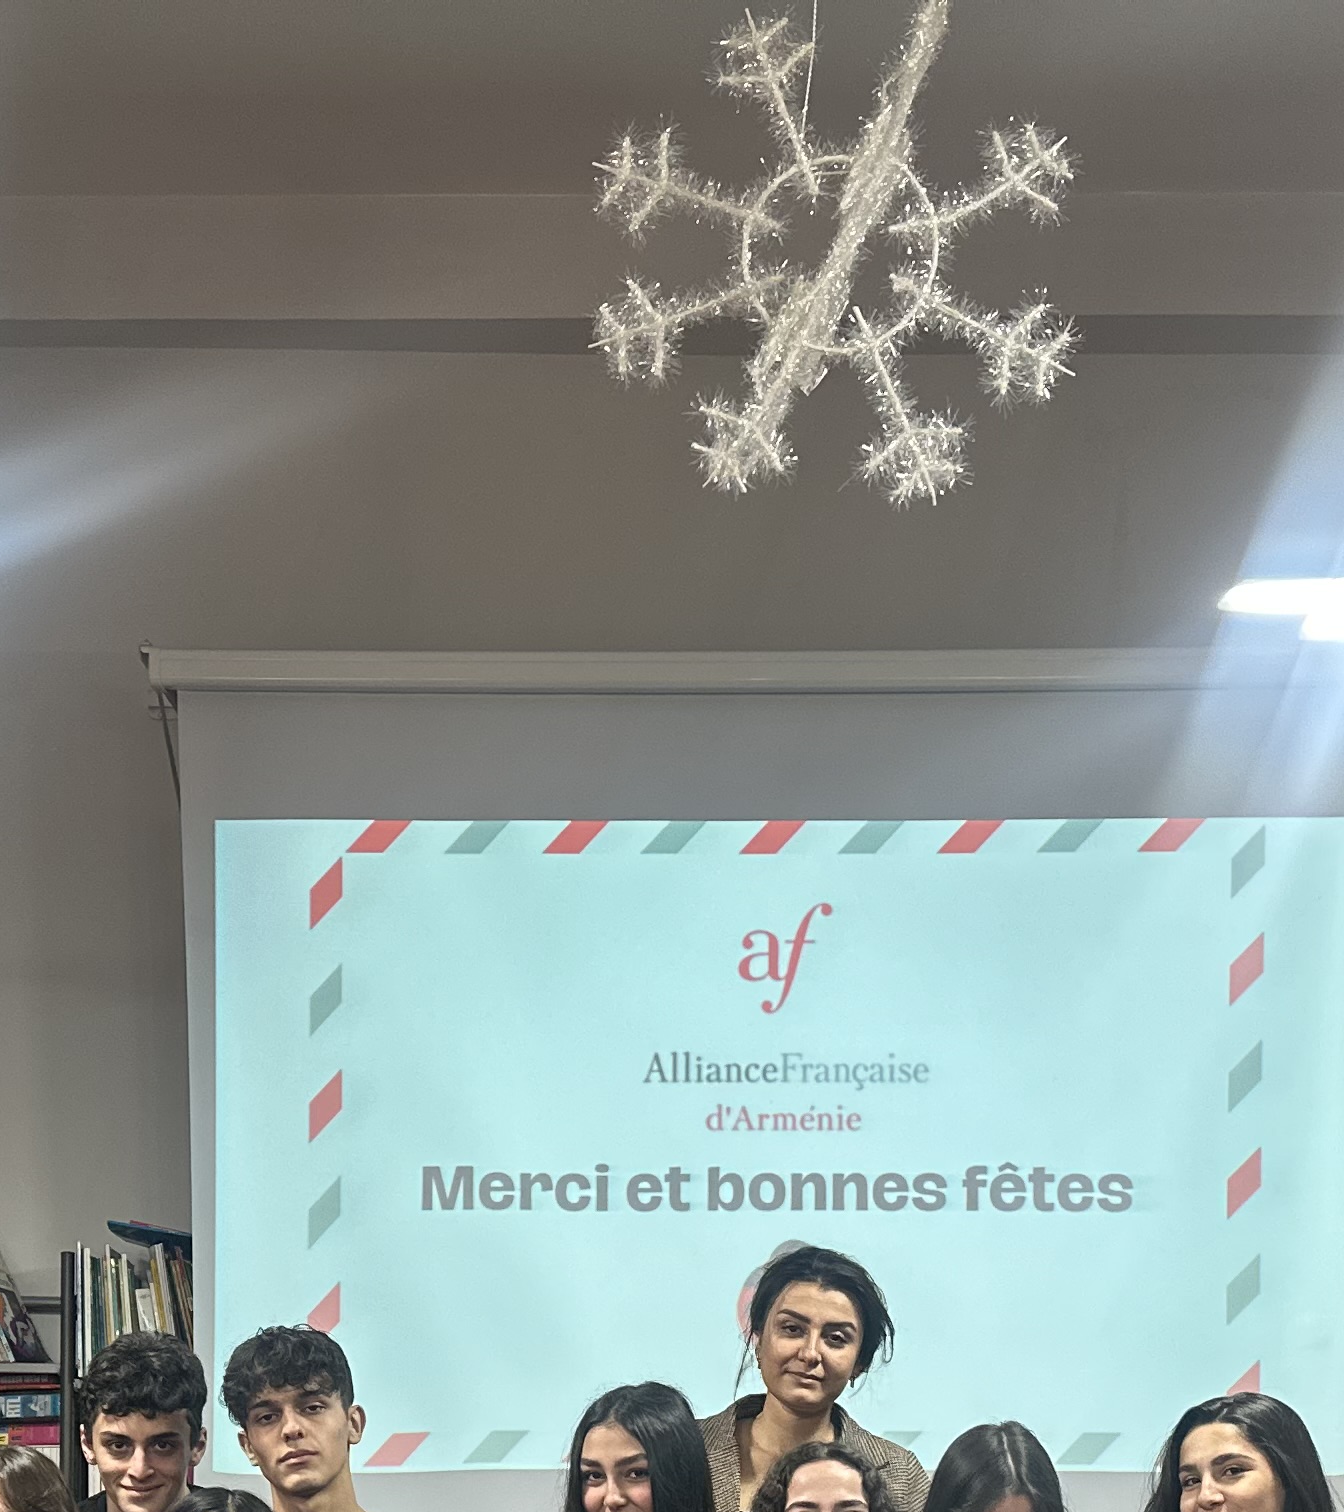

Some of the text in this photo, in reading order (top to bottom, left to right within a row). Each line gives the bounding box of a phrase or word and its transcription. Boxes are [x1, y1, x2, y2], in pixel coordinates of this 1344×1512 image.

[738, 902, 833, 1014] af
[705, 1104, 862, 1132] d'Arménie
[421, 1162, 1134, 1212] Merci et bonnes fêtes
